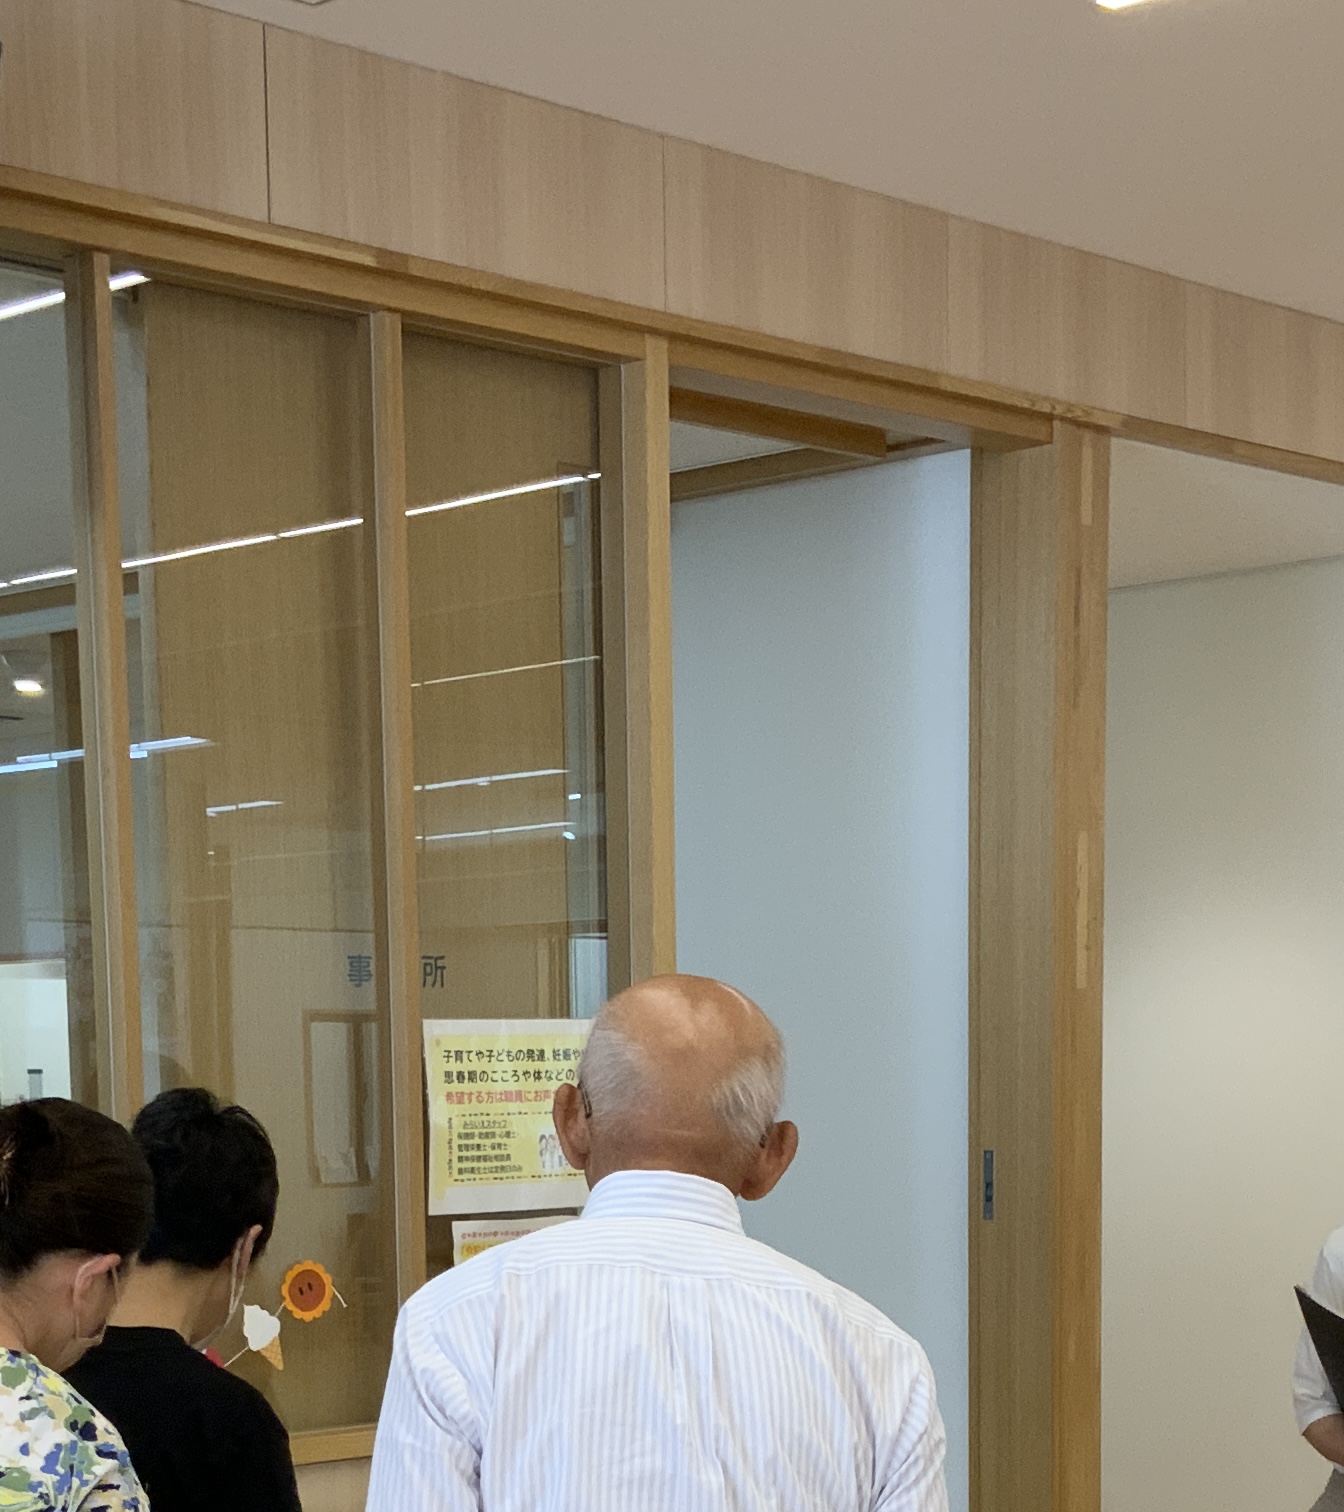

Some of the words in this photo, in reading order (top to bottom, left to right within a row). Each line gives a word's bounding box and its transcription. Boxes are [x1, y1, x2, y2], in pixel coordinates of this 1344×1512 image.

[443, 1049, 584, 1064] 子育てや子どもの発達、妊娠や
[443, 1068, 576, 1085] 思春期のこころや体などの
[445, 1089, 556, 1106] 希望する方は職員にお声
